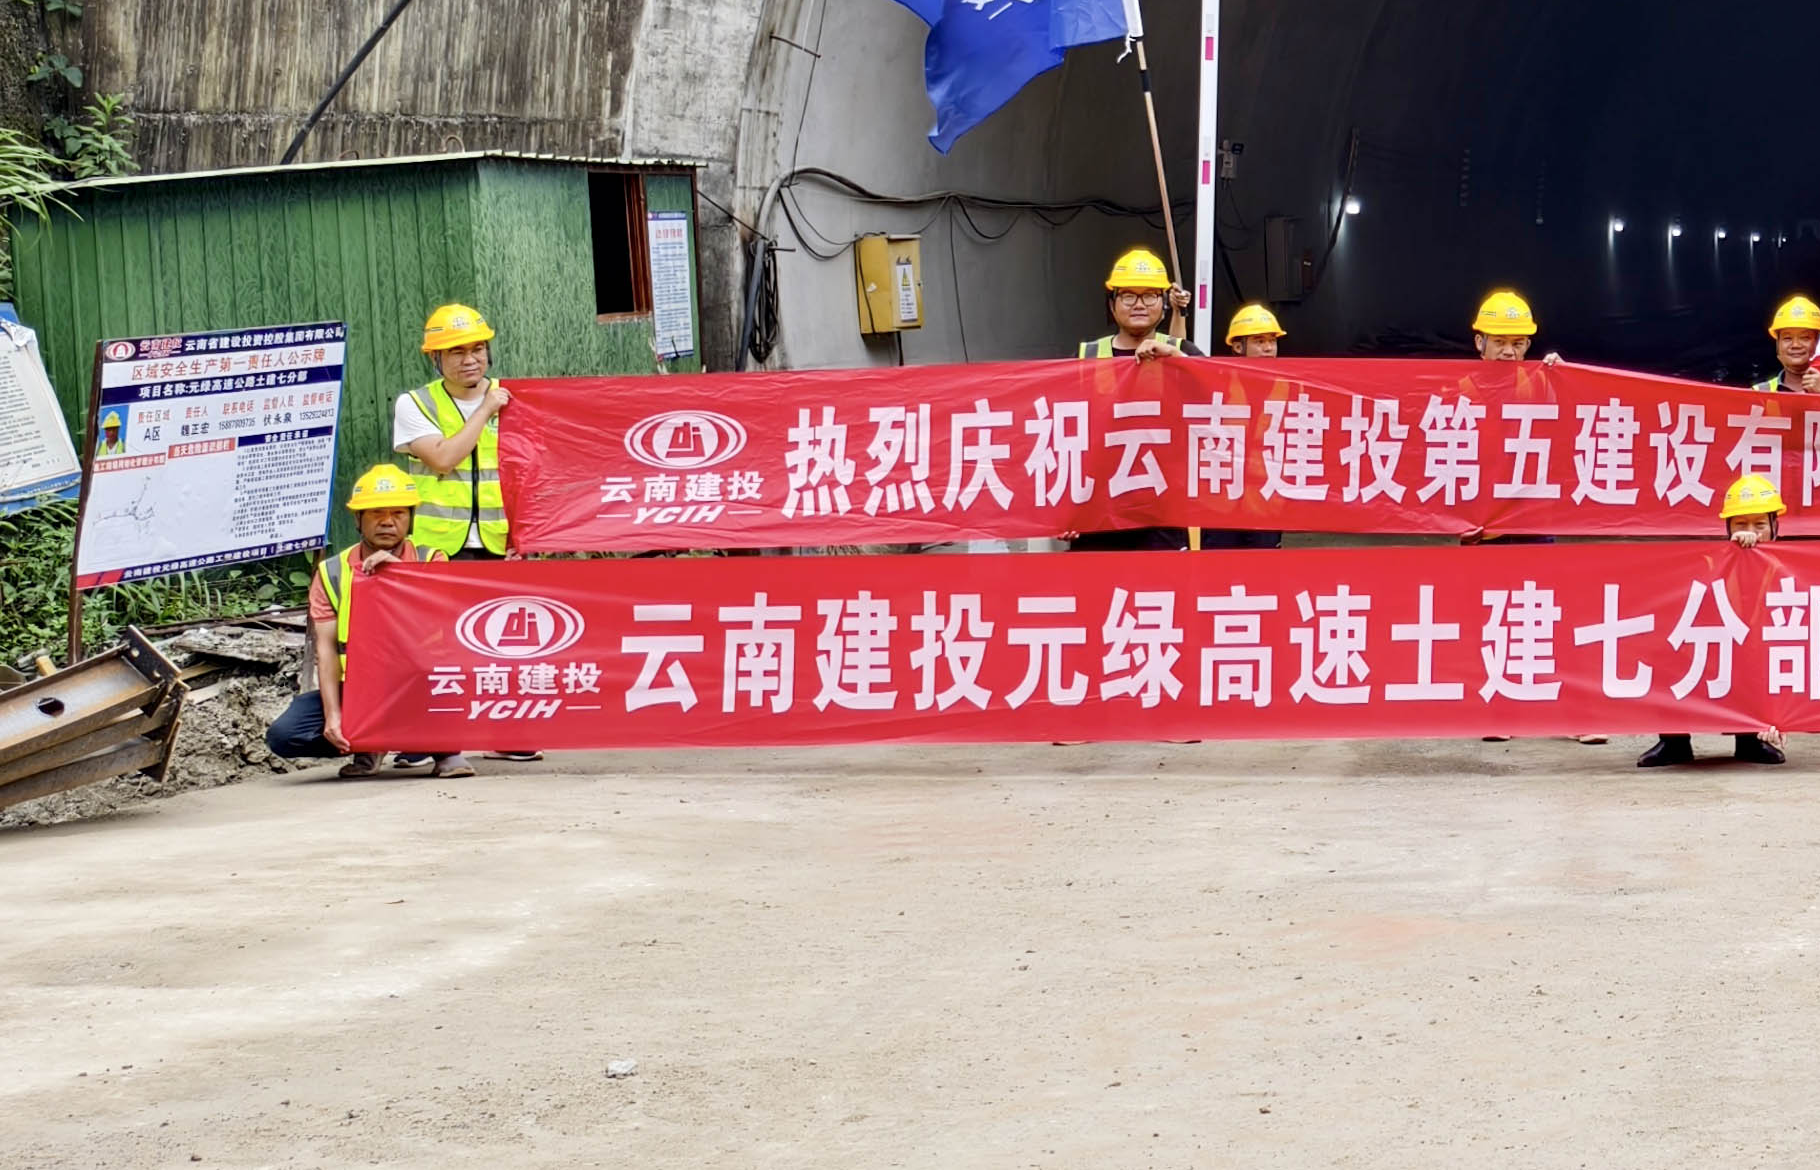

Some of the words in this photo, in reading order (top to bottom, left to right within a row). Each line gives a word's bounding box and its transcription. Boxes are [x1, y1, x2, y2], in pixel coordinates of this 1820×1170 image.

[132, 347, 327, 381] 区域安全生产第一责任人公示牌
[144, 425, 162, 442] A区
[600, 470, 765, 503] 云南建投
[633, 505, 726, 524] YCIH
[427, 662, 602, 695] 云南建投
[467, 699, 562, 720] YCIH
